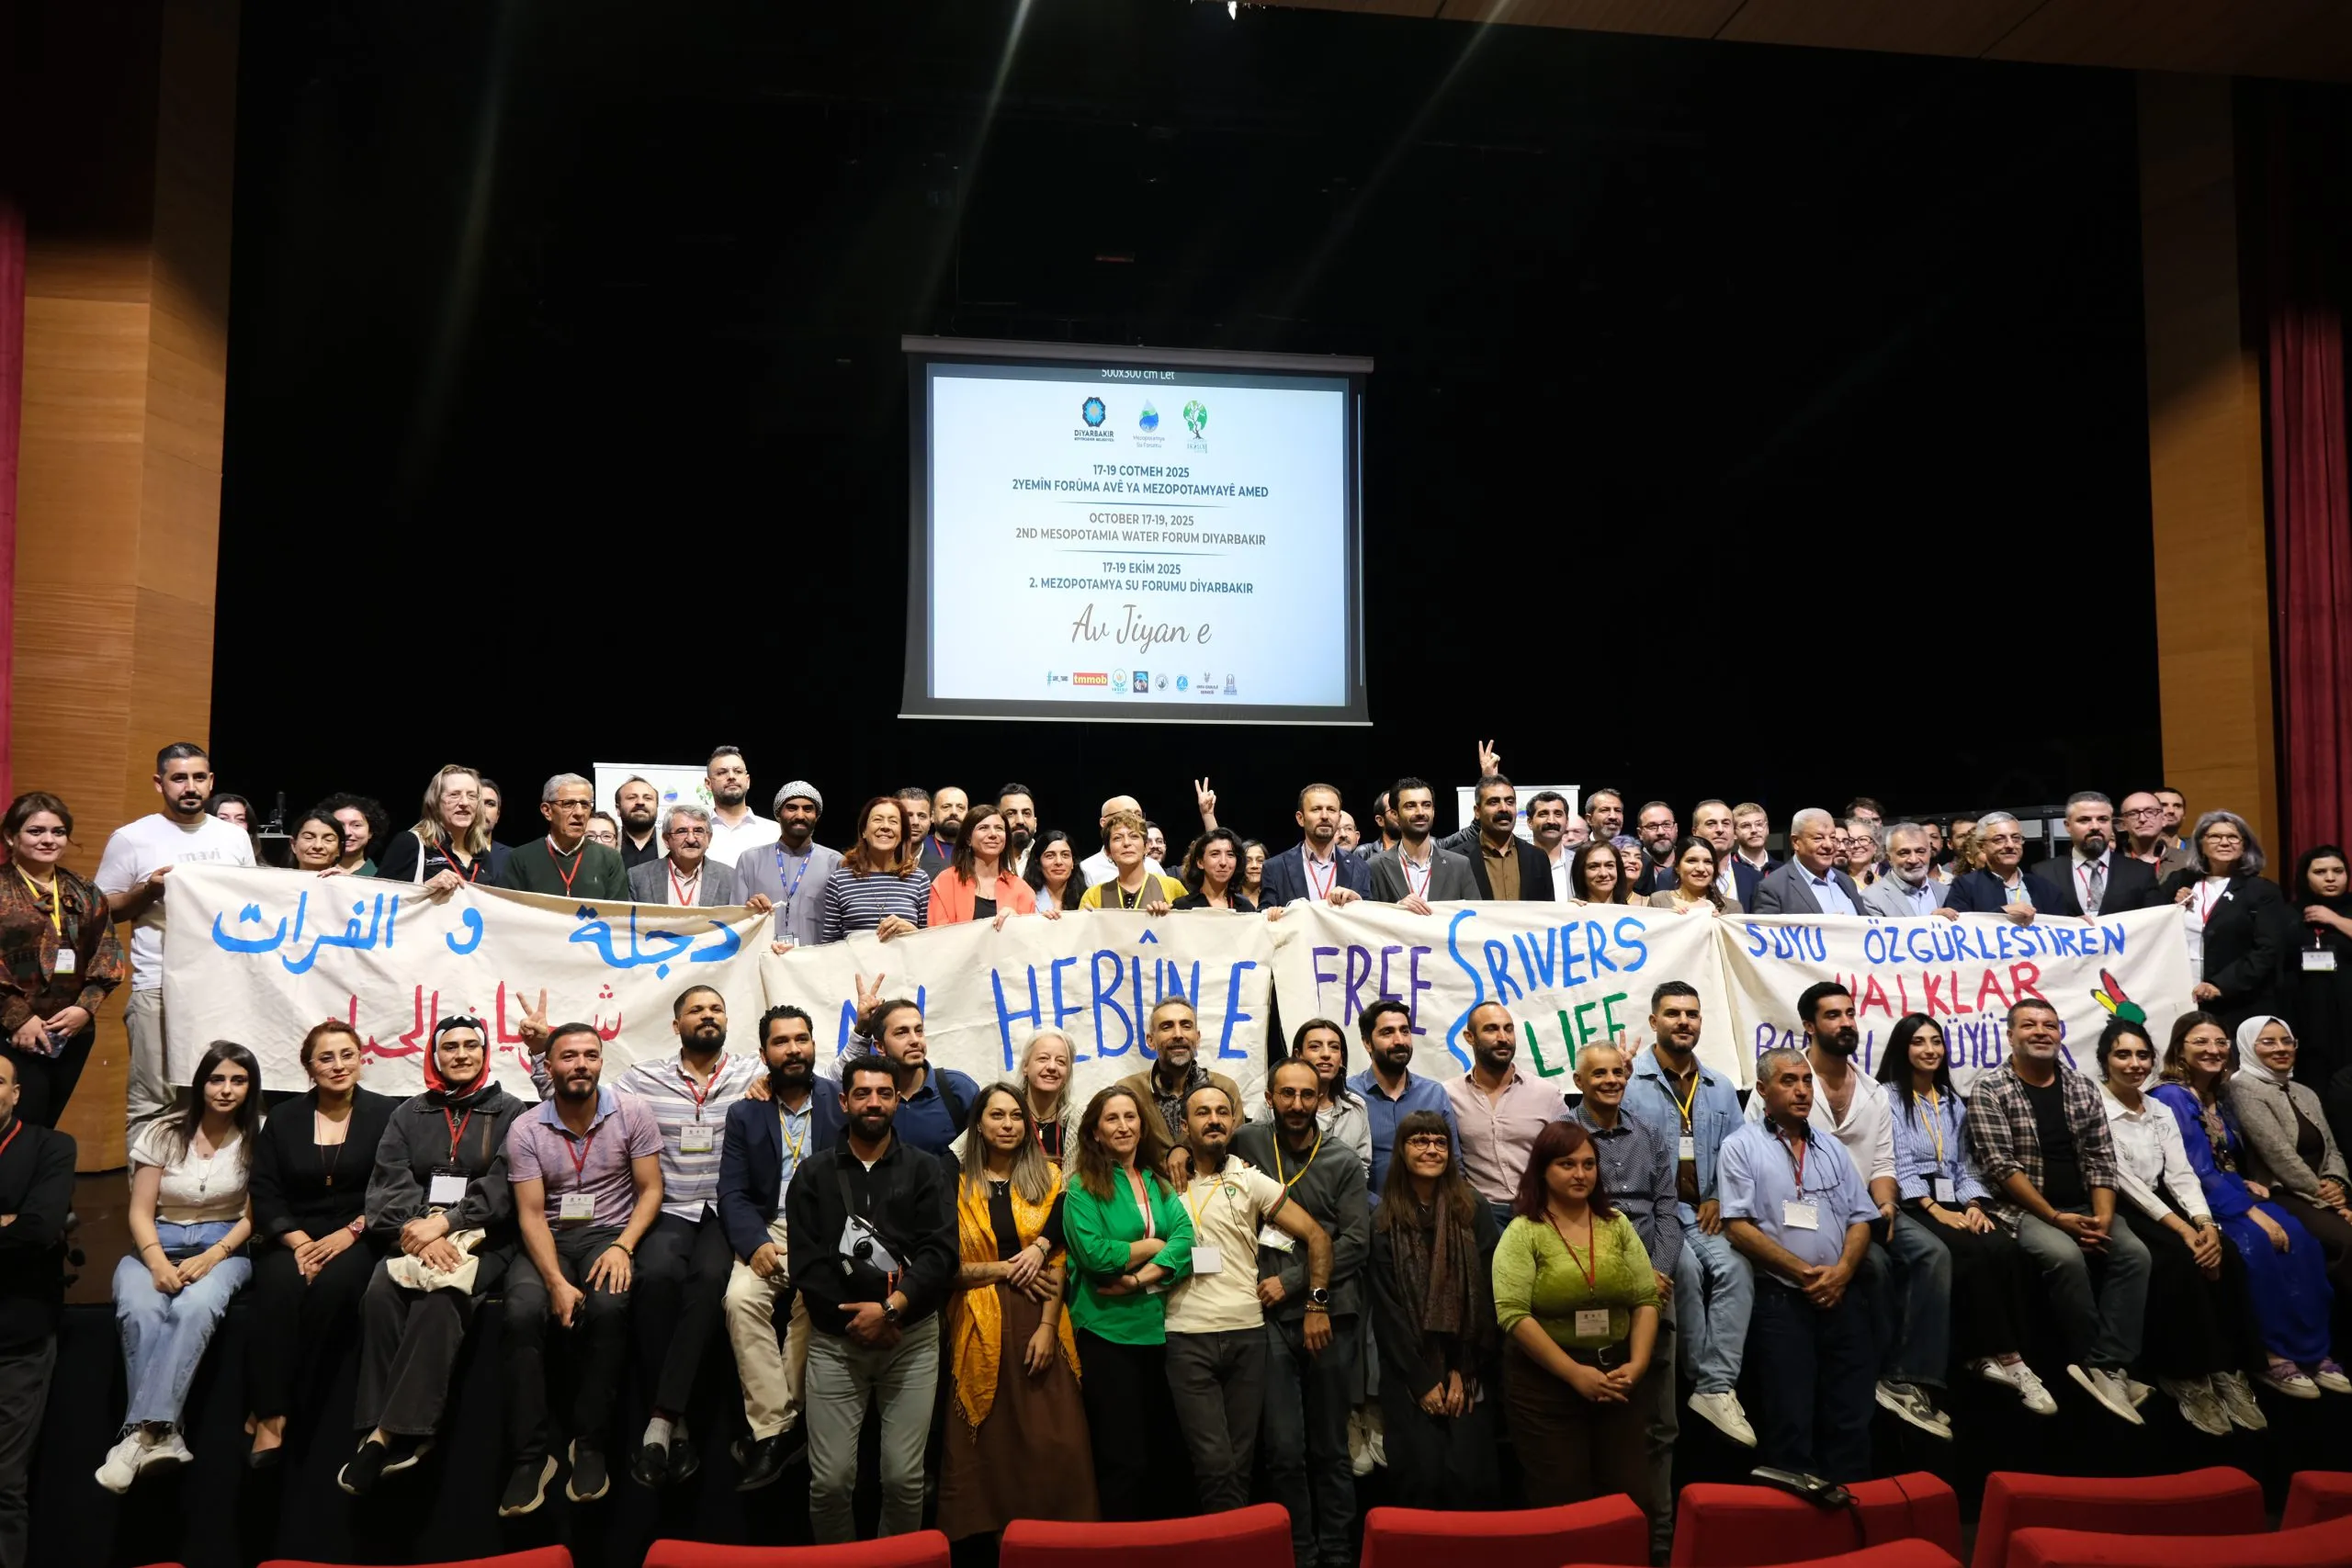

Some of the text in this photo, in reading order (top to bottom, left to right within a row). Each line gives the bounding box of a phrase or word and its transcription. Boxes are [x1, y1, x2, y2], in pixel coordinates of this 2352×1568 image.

[1143, 371, 1158, 379] cm
[1093, 464, 1190, 479] 17-19 COTMEH 2025
[1012, 476, 1270, 498] 2YEMÎN FORÛMA AVÊ YA MEZOPOTAMYAYÊ AMED
[1089, 513, 1194, 527] OCTOBER 17-19, 2025
[1015, 527, 1266, 546] 2ND MESOPOTAMIA WATER FORUM DIYARBAKIR
[1102, 559, 1182, 575] 17-19 EKİM 2025
[1029, 577, 1254, 594] 2. MEZOPOTAMYA SU FORUMU DİYARBAKIR
[1071, 603, 1213, 655] Av Jiyan e
[1073, 674, 1108, 685] tmmob
[211, 890, 742, 980] دجلة و الفرات
[1746, 922, 1827, 963] SUYU
[1483, 916, 1648, 1007] RIVERS
[1312, 944, 1432, 1036] FREE
[326, 983, 439, 1066] الحيا
